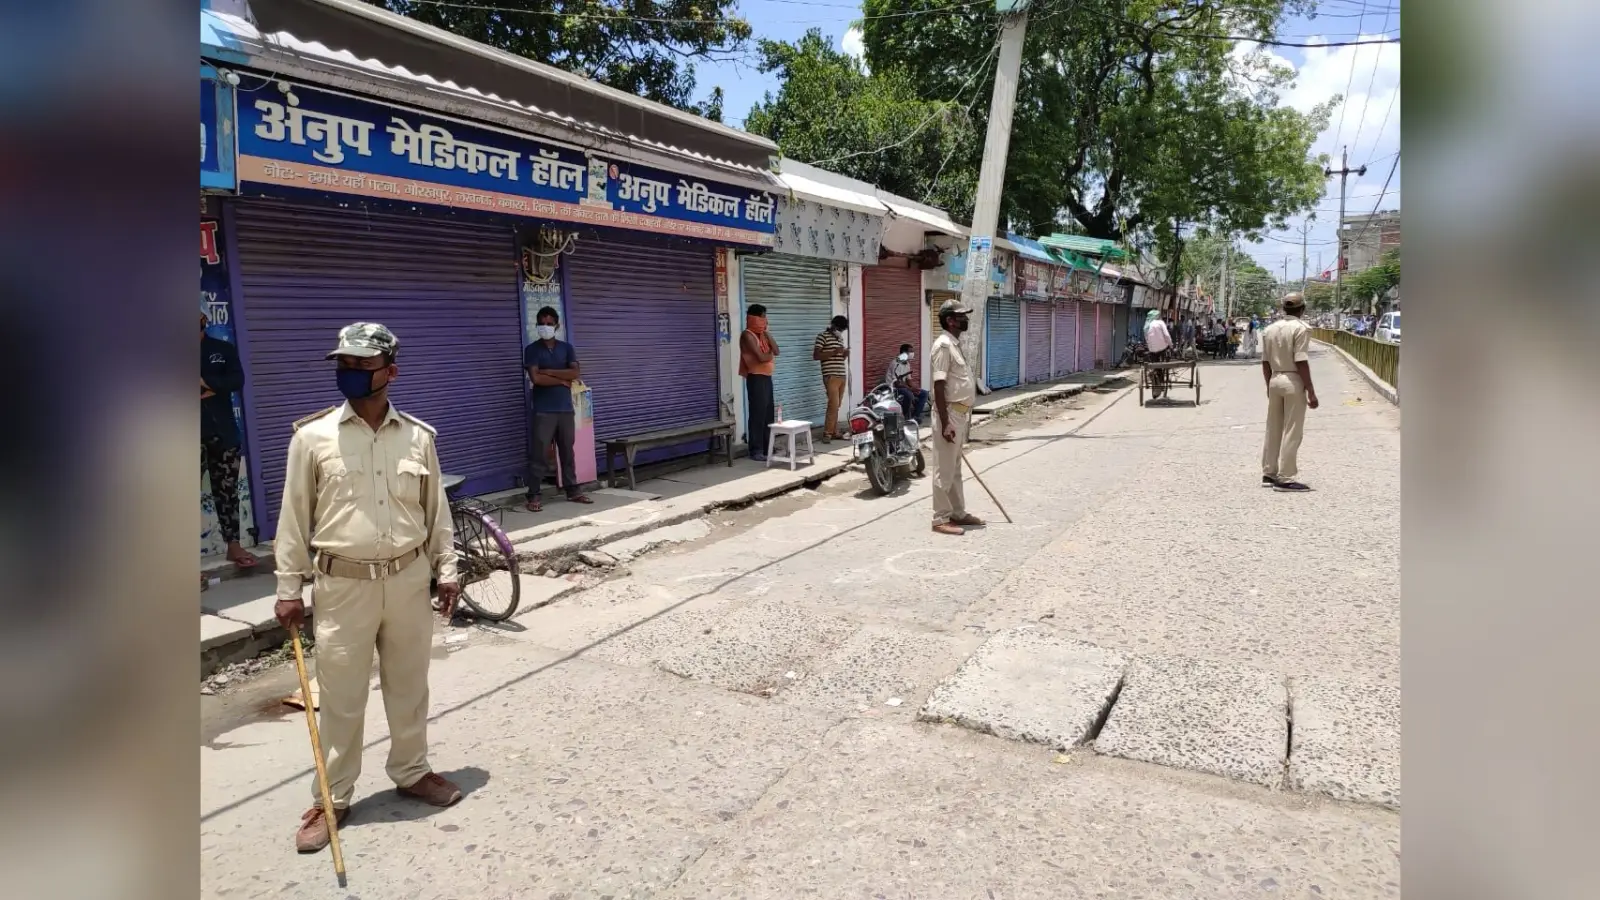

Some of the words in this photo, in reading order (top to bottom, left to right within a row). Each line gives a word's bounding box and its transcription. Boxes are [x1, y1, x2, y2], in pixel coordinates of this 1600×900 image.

[386, 116, 521, 181] मेडिकल
[529, 148, 587, 192] हॉल
[618, 172, 672, 213] अनुप
[676, 178, 741, 218] मेडिकल
